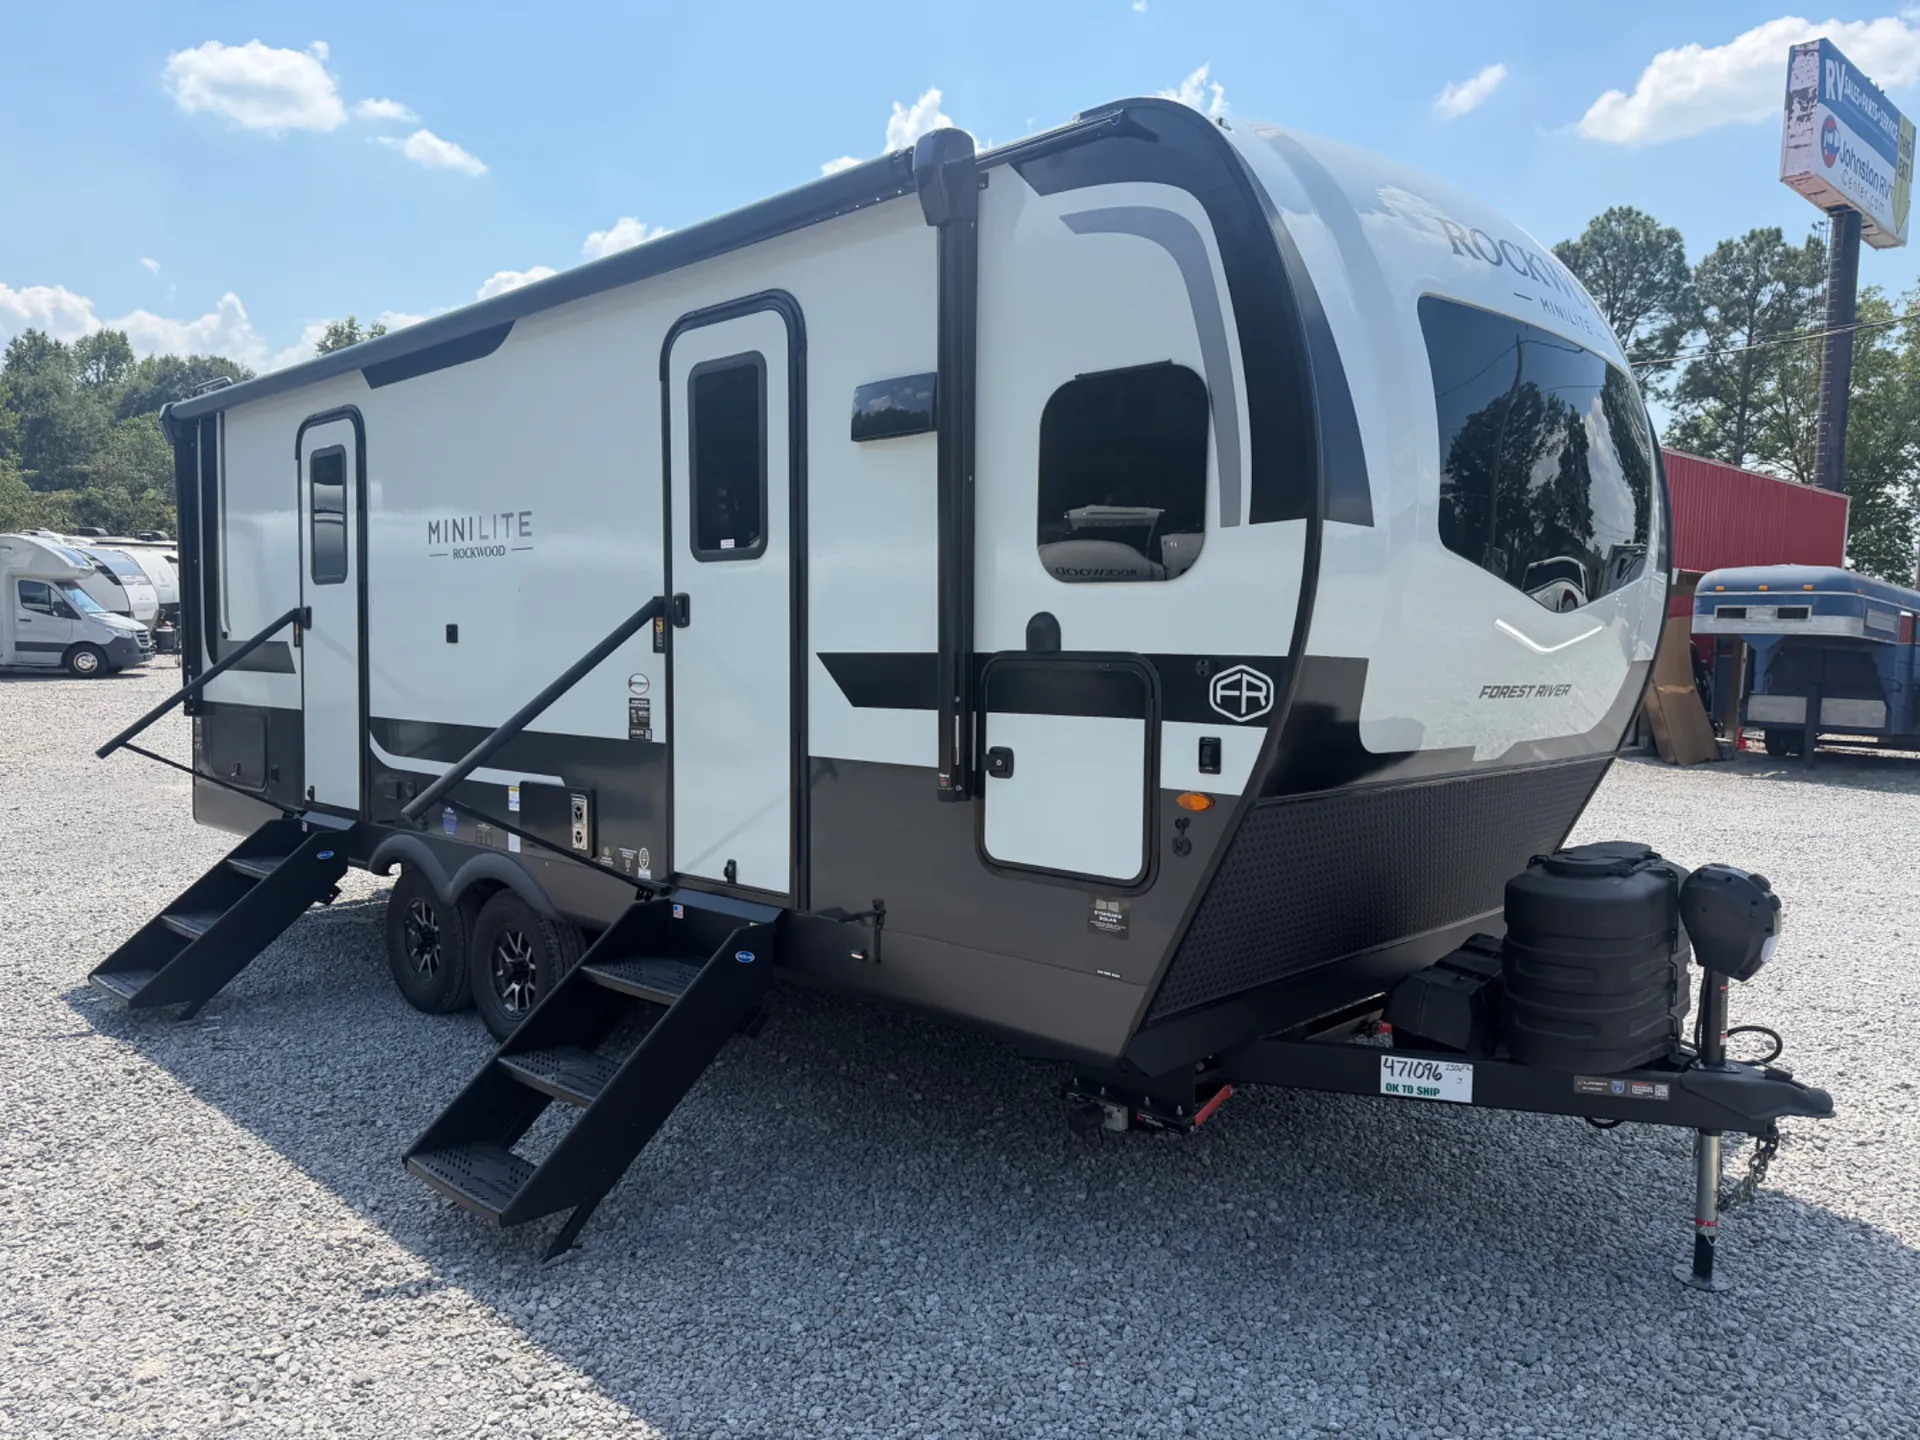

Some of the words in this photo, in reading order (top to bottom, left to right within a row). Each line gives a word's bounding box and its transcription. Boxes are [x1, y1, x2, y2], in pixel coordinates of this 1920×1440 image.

[1825, 58, 1846, 102] RV
[1539, 297, 1593, 335] MINILITE
[428, 511, 532, 545] MINILITE
[452, 545, 506, 559] ROCKWOOD
[1478, 684, 1536, 699] FOREST
[1534, 683, 1572, 698] RIVER
[1383, 1057, 1443, 1081] 471096
[1385, 1082, 1399, 1093] OK
[1402, 1084, 1414, 1095] TO
[1416, 1085, 1440, 1097] SHIP
